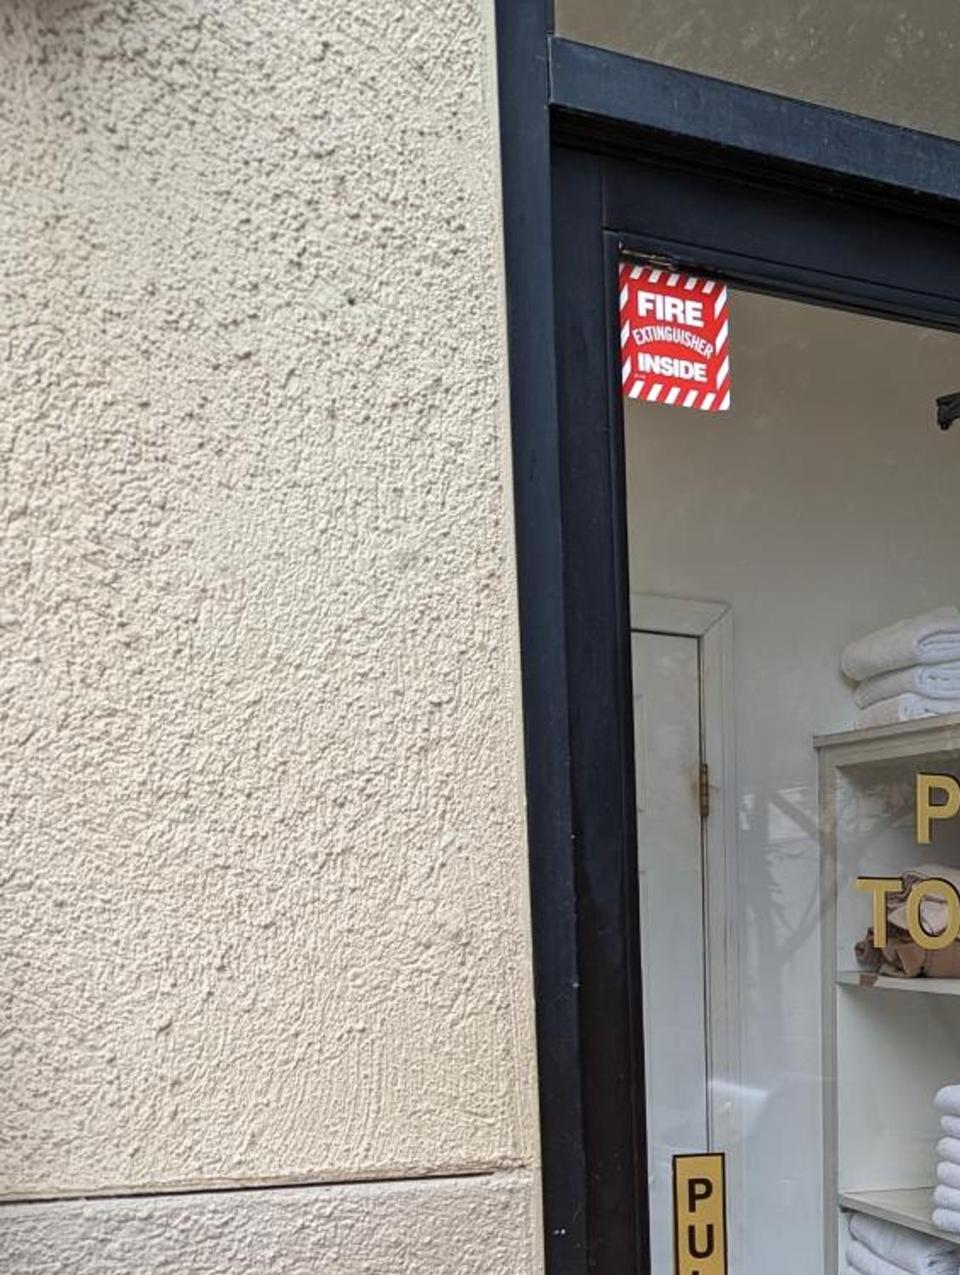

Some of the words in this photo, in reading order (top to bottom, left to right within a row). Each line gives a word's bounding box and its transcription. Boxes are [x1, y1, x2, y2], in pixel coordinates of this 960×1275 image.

[637, 290, 704, 327] FIRE
[632, 325, 714, 359] EXTINGUISHER
[637, 352, 708, 382] INSIDE
